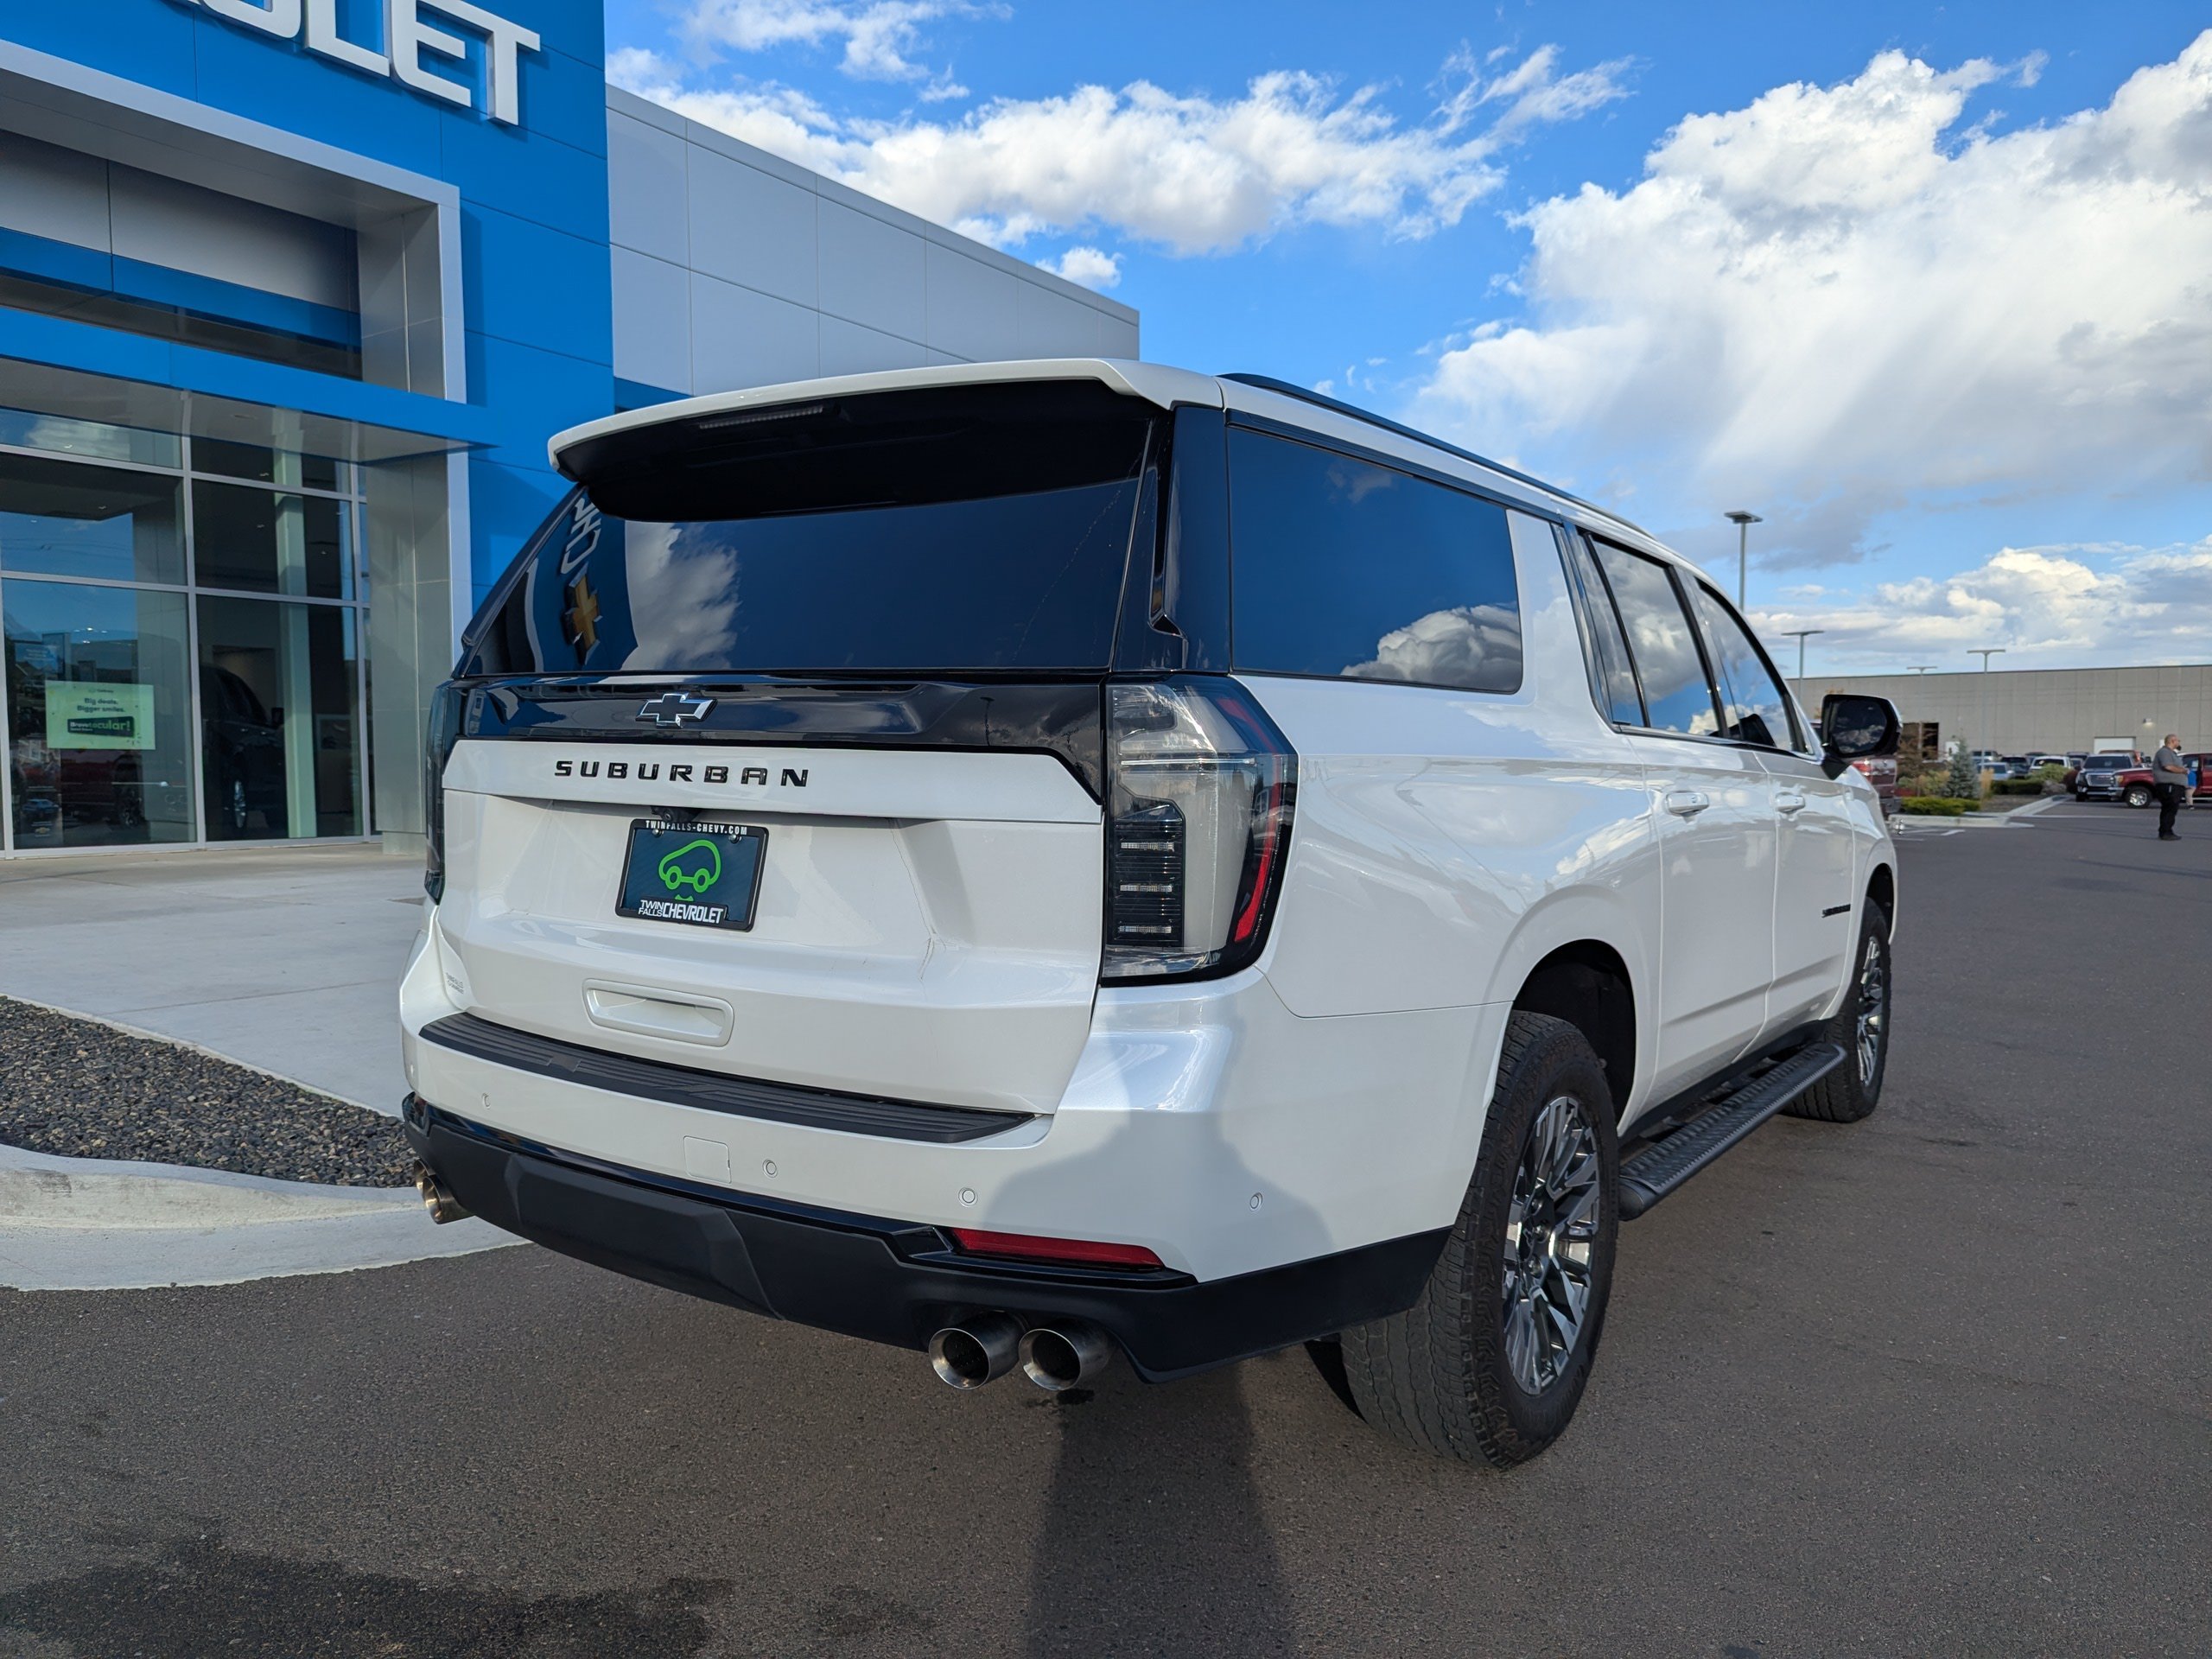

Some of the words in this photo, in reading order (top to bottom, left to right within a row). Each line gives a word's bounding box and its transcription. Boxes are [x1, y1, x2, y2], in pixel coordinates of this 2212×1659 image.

[85, 697, 96, 706] Big
[554, 760, 809, 787] SUBURBAN
[640, 899, 664, 910] TWIN
[638, 907, 663, 917] FALLS
[662, 902, 724, 924] CHEVROLET
